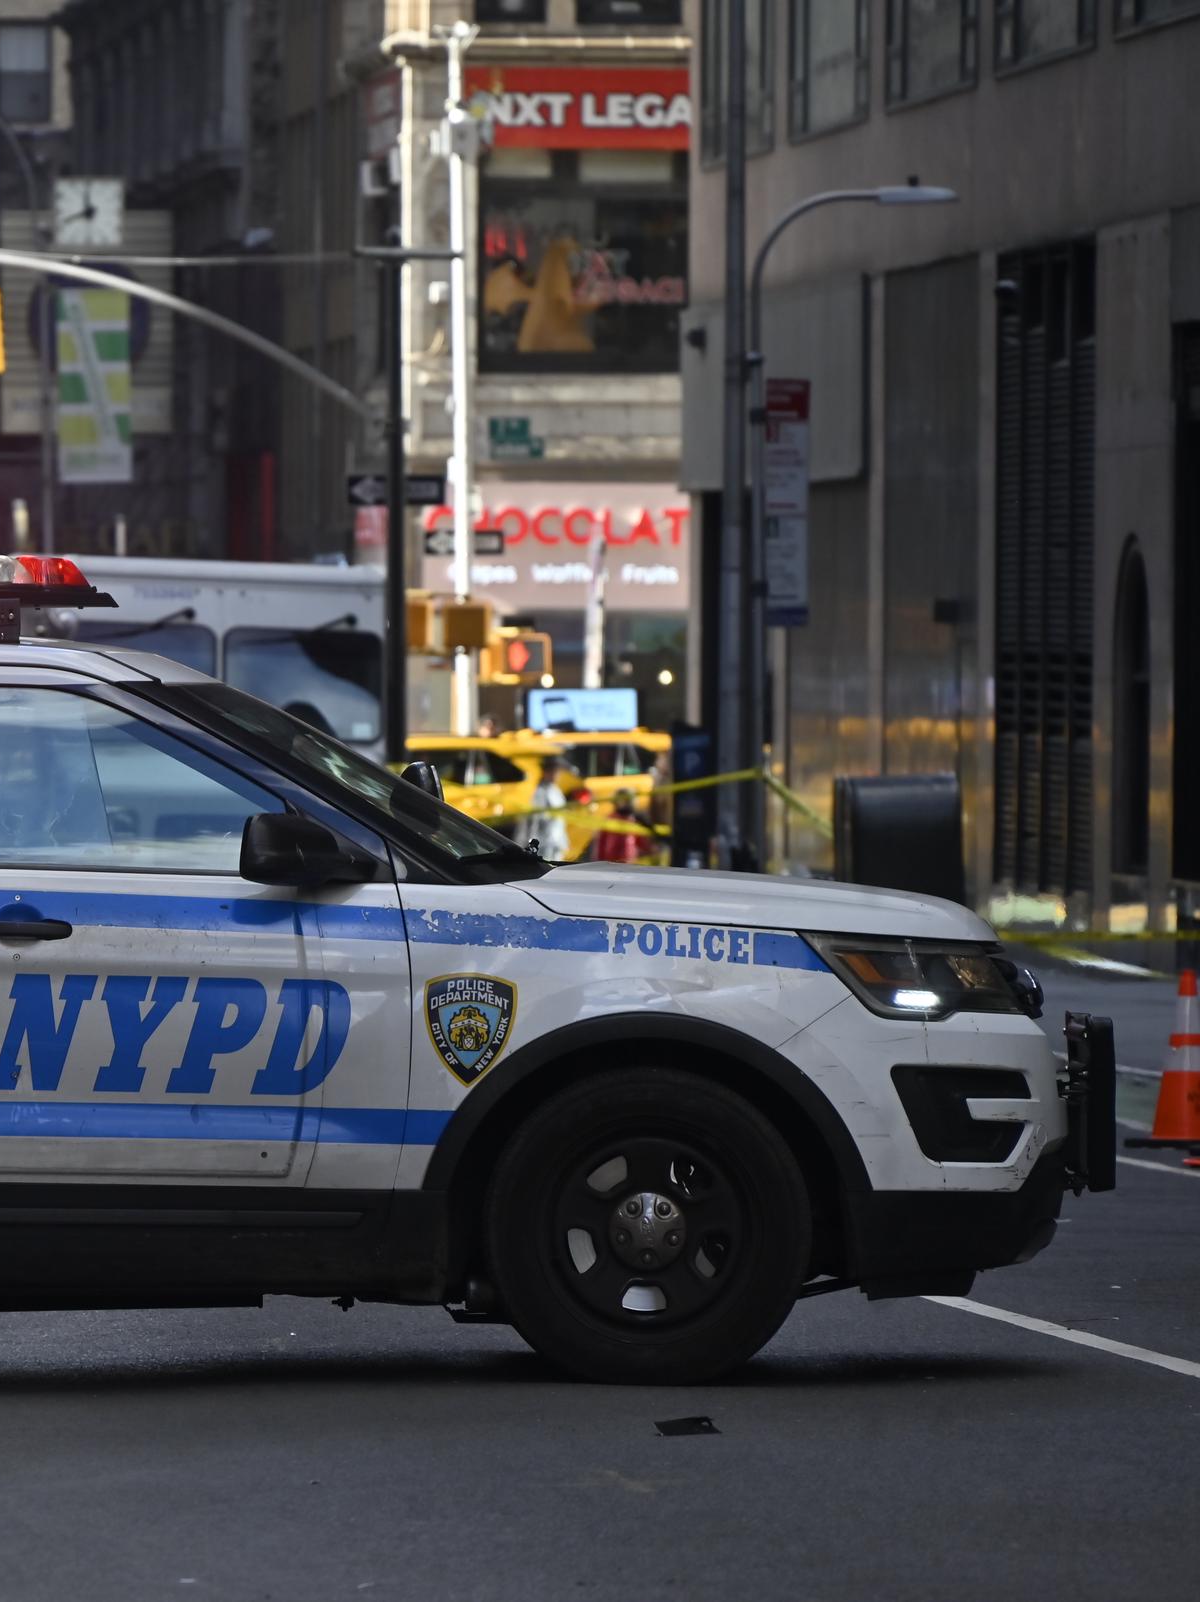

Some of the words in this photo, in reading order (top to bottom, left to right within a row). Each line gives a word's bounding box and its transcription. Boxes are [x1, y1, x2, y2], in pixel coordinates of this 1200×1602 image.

[424, 505, 691, 546] COCOLAT
[612, 922, 750, 965] POLICE
[430, 990, 510, 1011] DEPARTMENT
[447, 979, 495, 994] POLICE
[431, 1022, 448, 1049] CITY
[444, 1052, 459, 1066] OF
[474, 1048, 495, 1072] NEW
[492, 1016, 510, 1046] YORK
